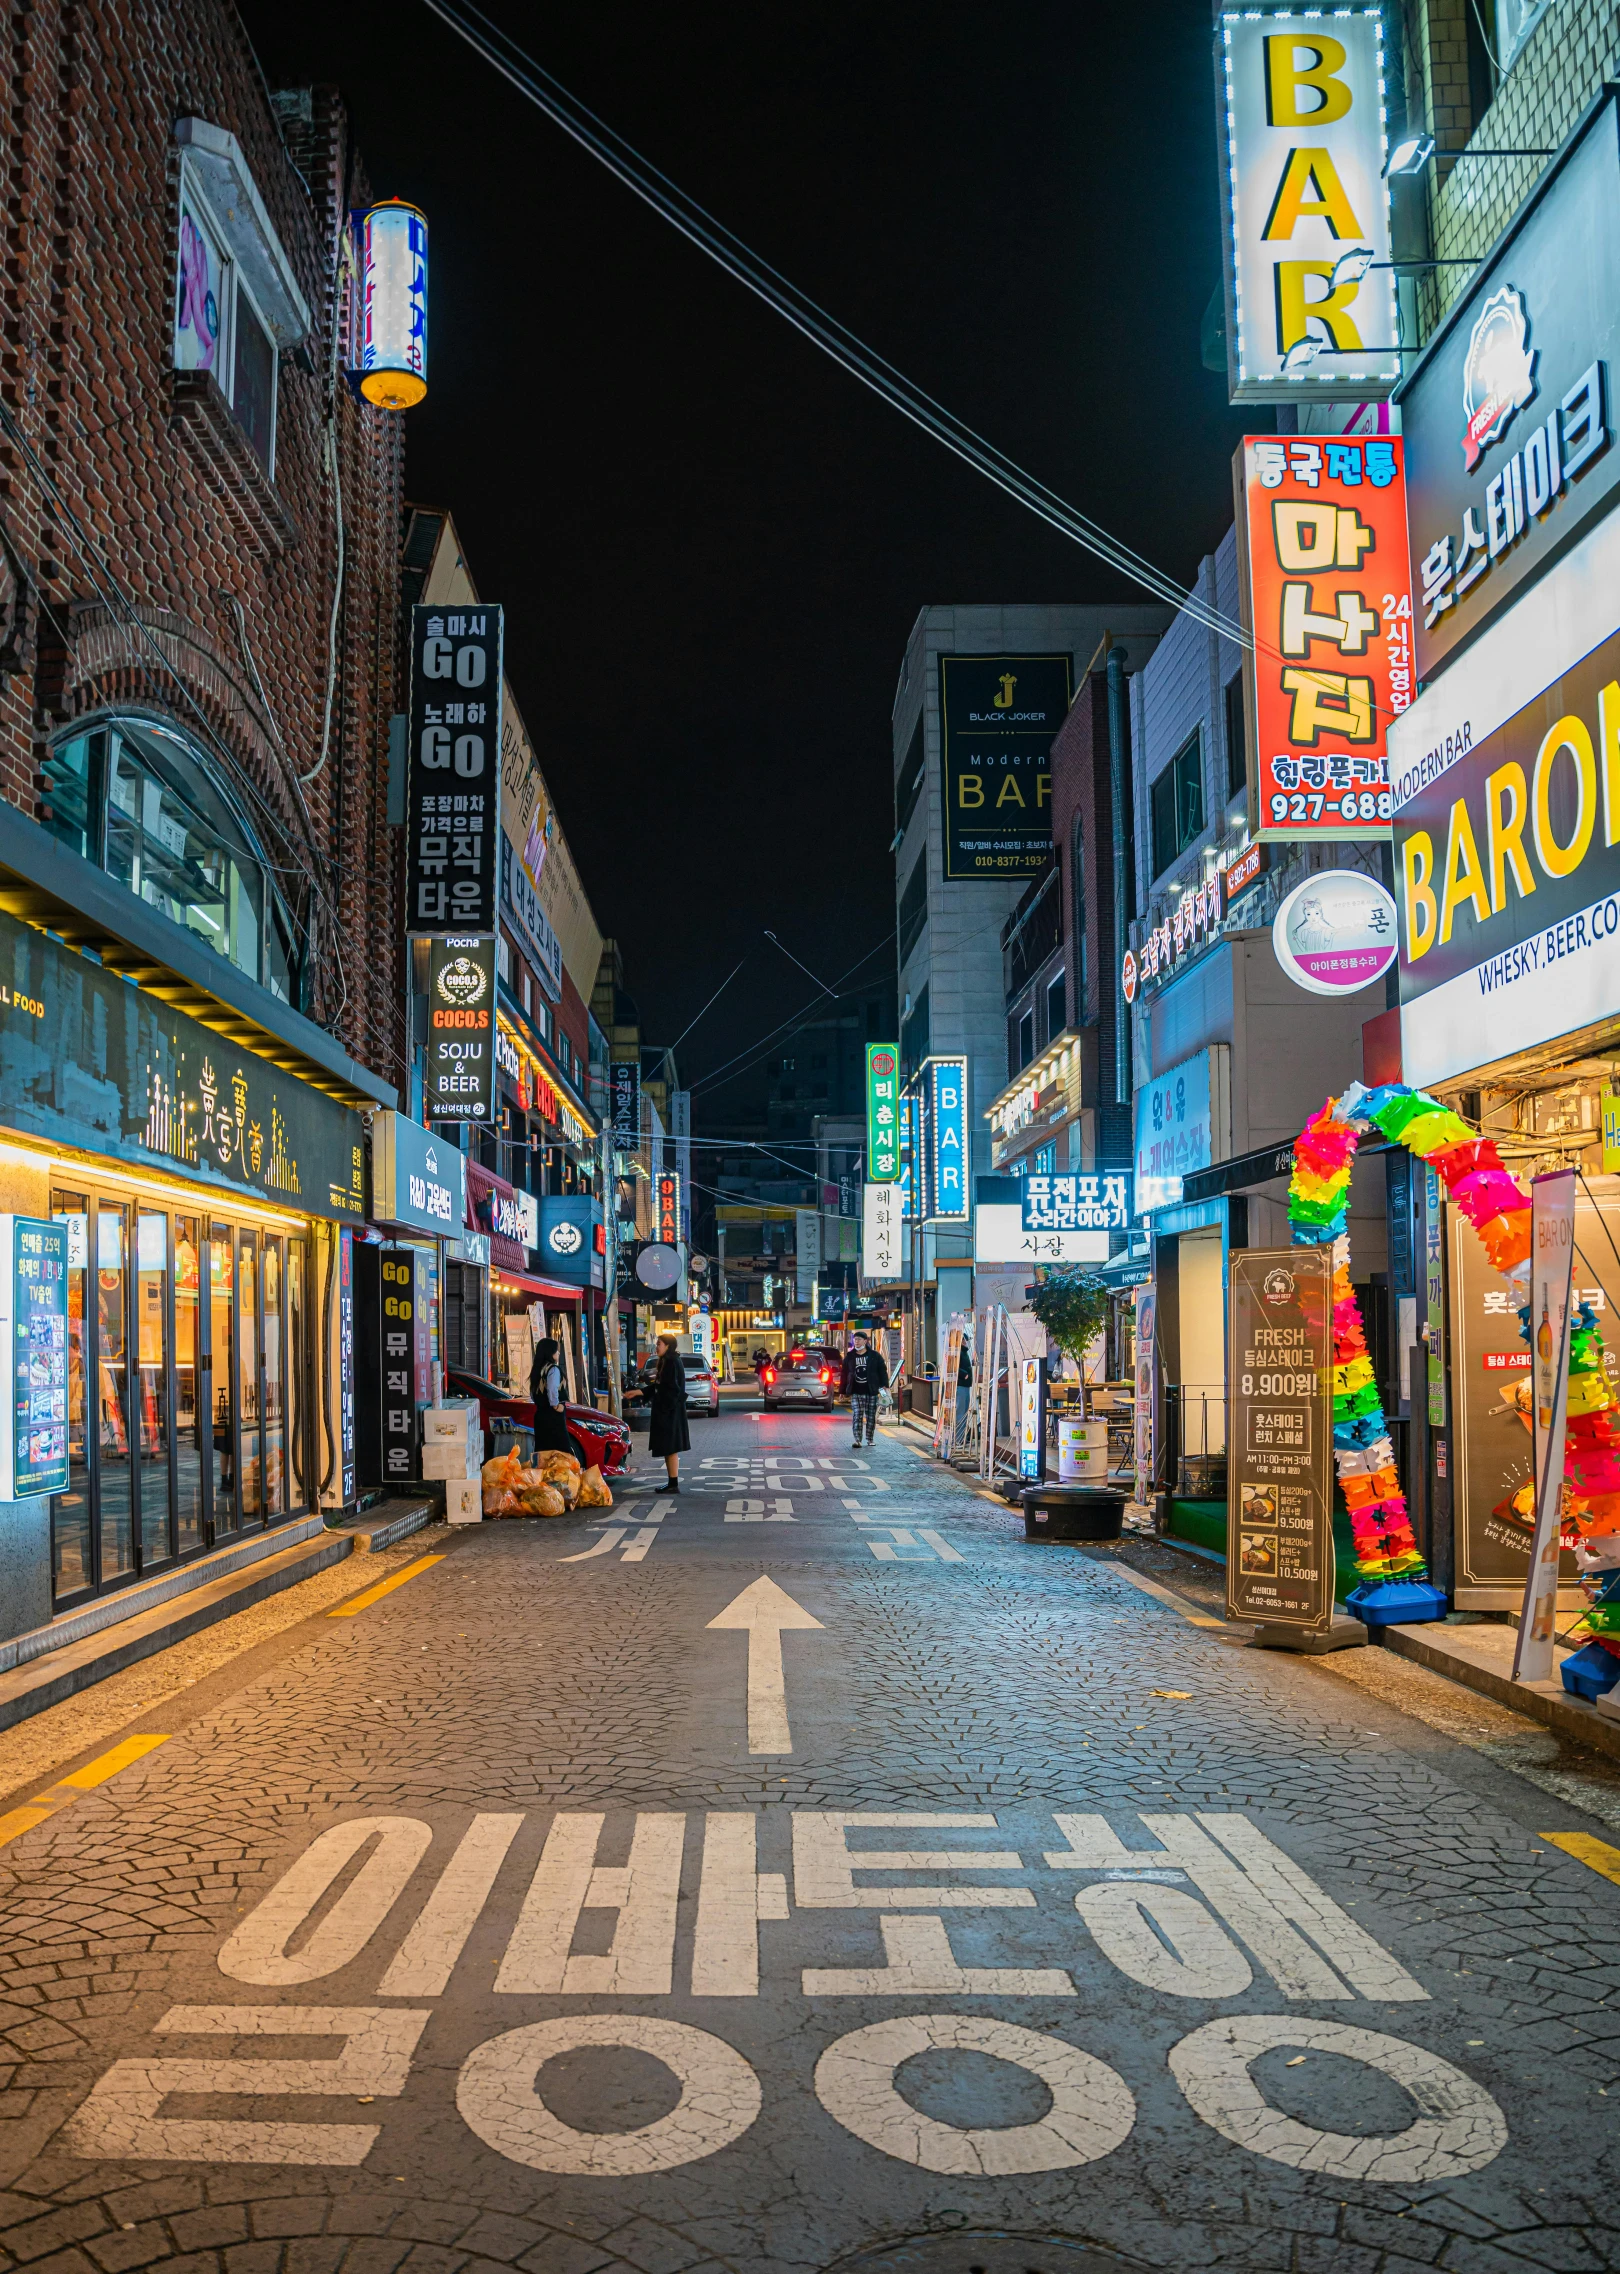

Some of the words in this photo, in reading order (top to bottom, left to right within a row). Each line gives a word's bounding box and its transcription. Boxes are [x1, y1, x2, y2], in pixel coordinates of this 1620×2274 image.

[1262, 33, 1366, 356] BAR
[1421, 359, 1607, 630] 훗스테이크
[426, 615, 486, 636] 술마시
[1271, 499, 1381, 748] 마사지
[422, 636, 486, 688] GO
[424, 702, 486, 724] 노래하
[969, 712, 1005, 721] BLACK
[1008, 712, 1046, 721] JOKER
[420, 725, 484, 778] GO
[970, 754, 1046, 766] Modern
[1392, 748, 1446, 811] MODERN
[1446, 720, 1473, 767] BAR
[421, 795, 485, 812] 포장마차
[421, 816, 484, 833] 가격으로
[418, 836, 481, 875] 뮤직
[1026, 841, 1047, 849] 초보자
[417, 881, 480, 920] 타운
[1368, 907, 1390, 934] 폰
[1310, 956, 1378, 971] 아이폰정품수리
[13, 990, 45, 1019] FOOD
[433, 1010, 489, 1030] COCO,S
[438, 1043, 482, 1059] SOJU
[454, 1062, 465, 1074] &
[439, 1076, 480, 1092] BEER
[433, 1104, 471, 1114] 성신여대점
[615, 1080, 633, 1149] 제임스포차
[874, 1080, 896, 1173] 리춘시장
[941, 1087, 960, 1189] BAR
[409, 1173, 426, 1211] R&D
[426, 1180, 452, 1222] 교육센터
[1026, 1176, 1127, 1210] 퓨전포차
[661, 1196, 677, 1242] BAR
[875, 1189, 893, 1269] 혜화시장
[21, 1232, 43, 1254] 연매출
[44, 1236, 61, 1256] 25억
[1538, 1219, 1558, 1249] BAR
[18, 1257, 40, 1278] 화제의
[382, 1260, 410, 1286] GO
[417, 1259, 427, 1291] GO
[28, 1284, 53, 1304] TV출연
[385, 1296, 412, 1321] GO
[417, 1293, 428, 1325] GO
[1254, 1328, 1305, 1346] FRESH
[1244, 1349, 1315, 1367] 등심스테이크
[1487, 1355, 1506, 1366] 등심
[1241, 1373, 1318, 1397] 8,900원!
[386, 1331, 412, 1473] 뮤직타운
[1255, 1413, 1304, 1429] 훗스테이크
[1255, 1431, 1273, 1444] 런치
[1276, 1431, 1303, 1445] 스페셜
[1246, 1454, 1257, 1463] AM
[1293, 1456, 1311, 1466] 3:00
[343, 1471, 353, 1497] 2F
[1251, 1585, 1277, 1596] 성신여대점
[1301, 1601, 1310, 1611] 2F
